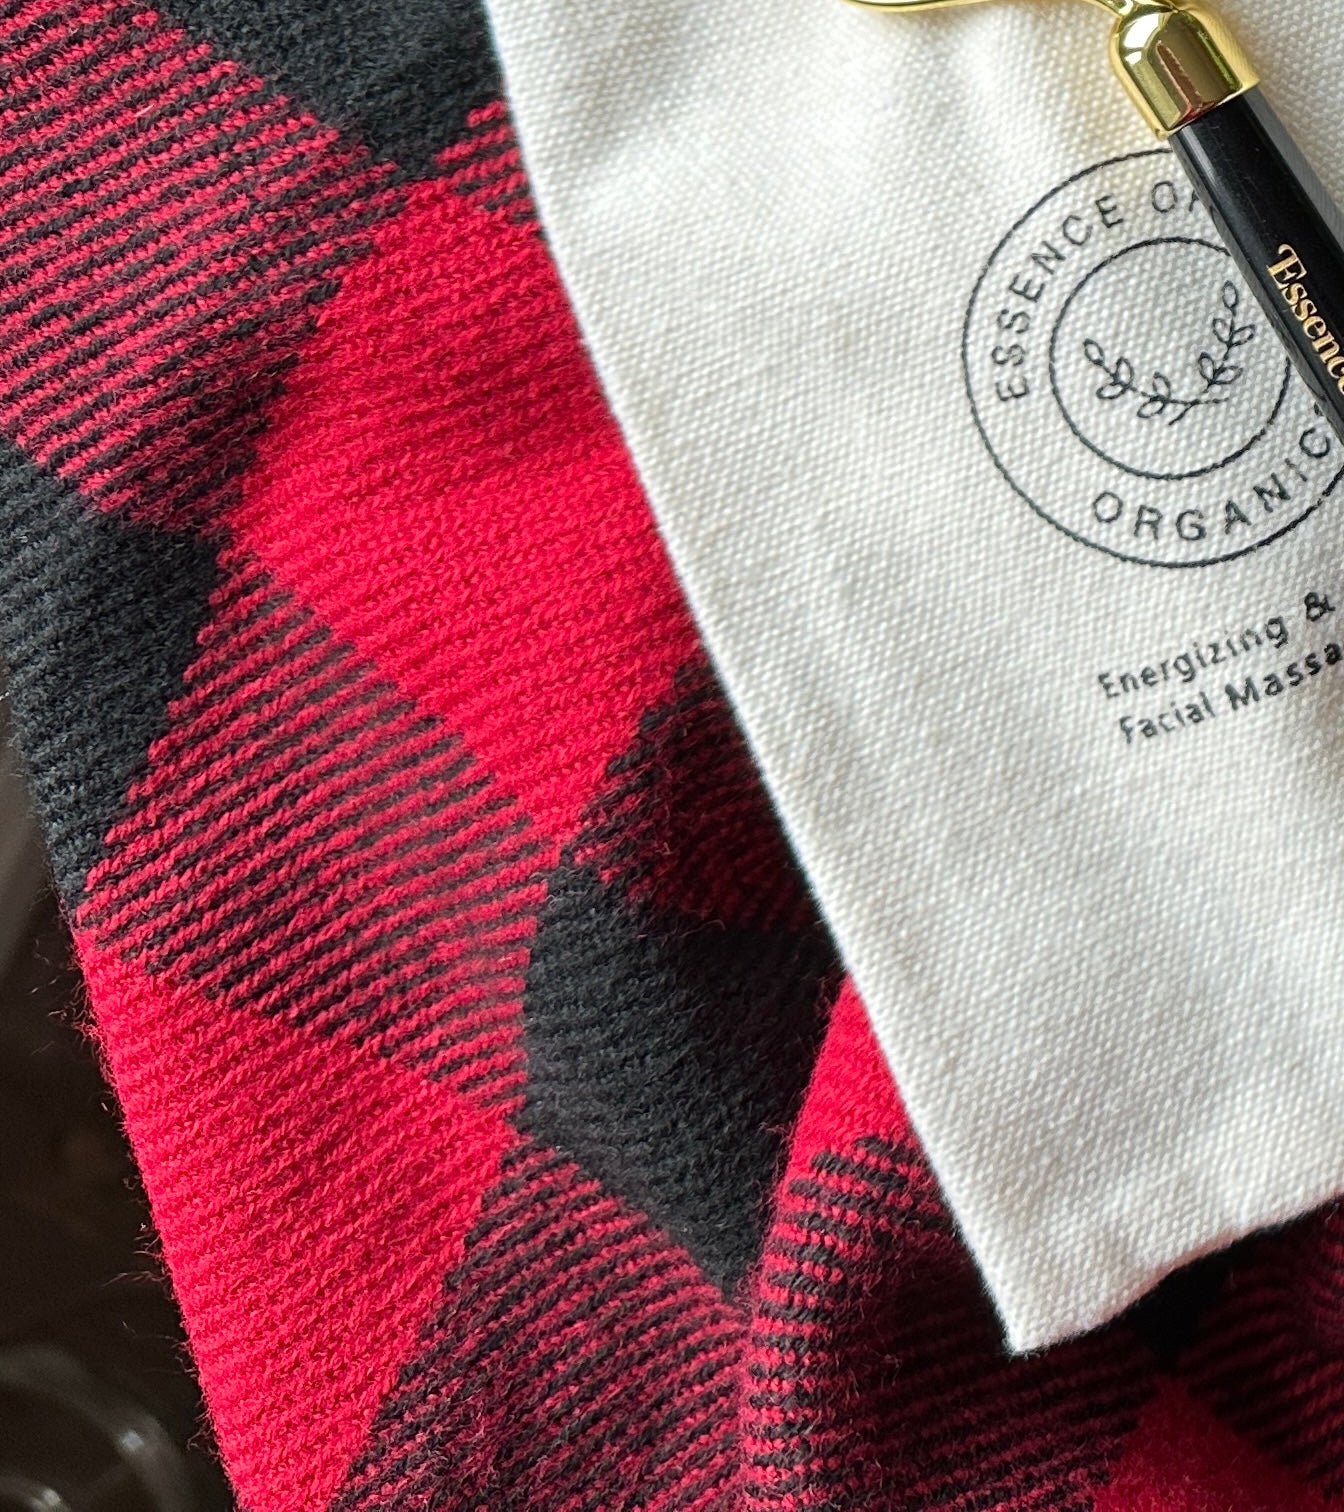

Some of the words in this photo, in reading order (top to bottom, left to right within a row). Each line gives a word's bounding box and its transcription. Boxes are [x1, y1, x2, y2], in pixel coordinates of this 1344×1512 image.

[991, 195, 1124, 402] ESSENCE
[1091, 400, 1331, 541] ORGANIC
[1098, 616, 1290, 699] Energizing
[1304, 591, 1336, 622] &
[1120, 691, 1216, 745] Facial
